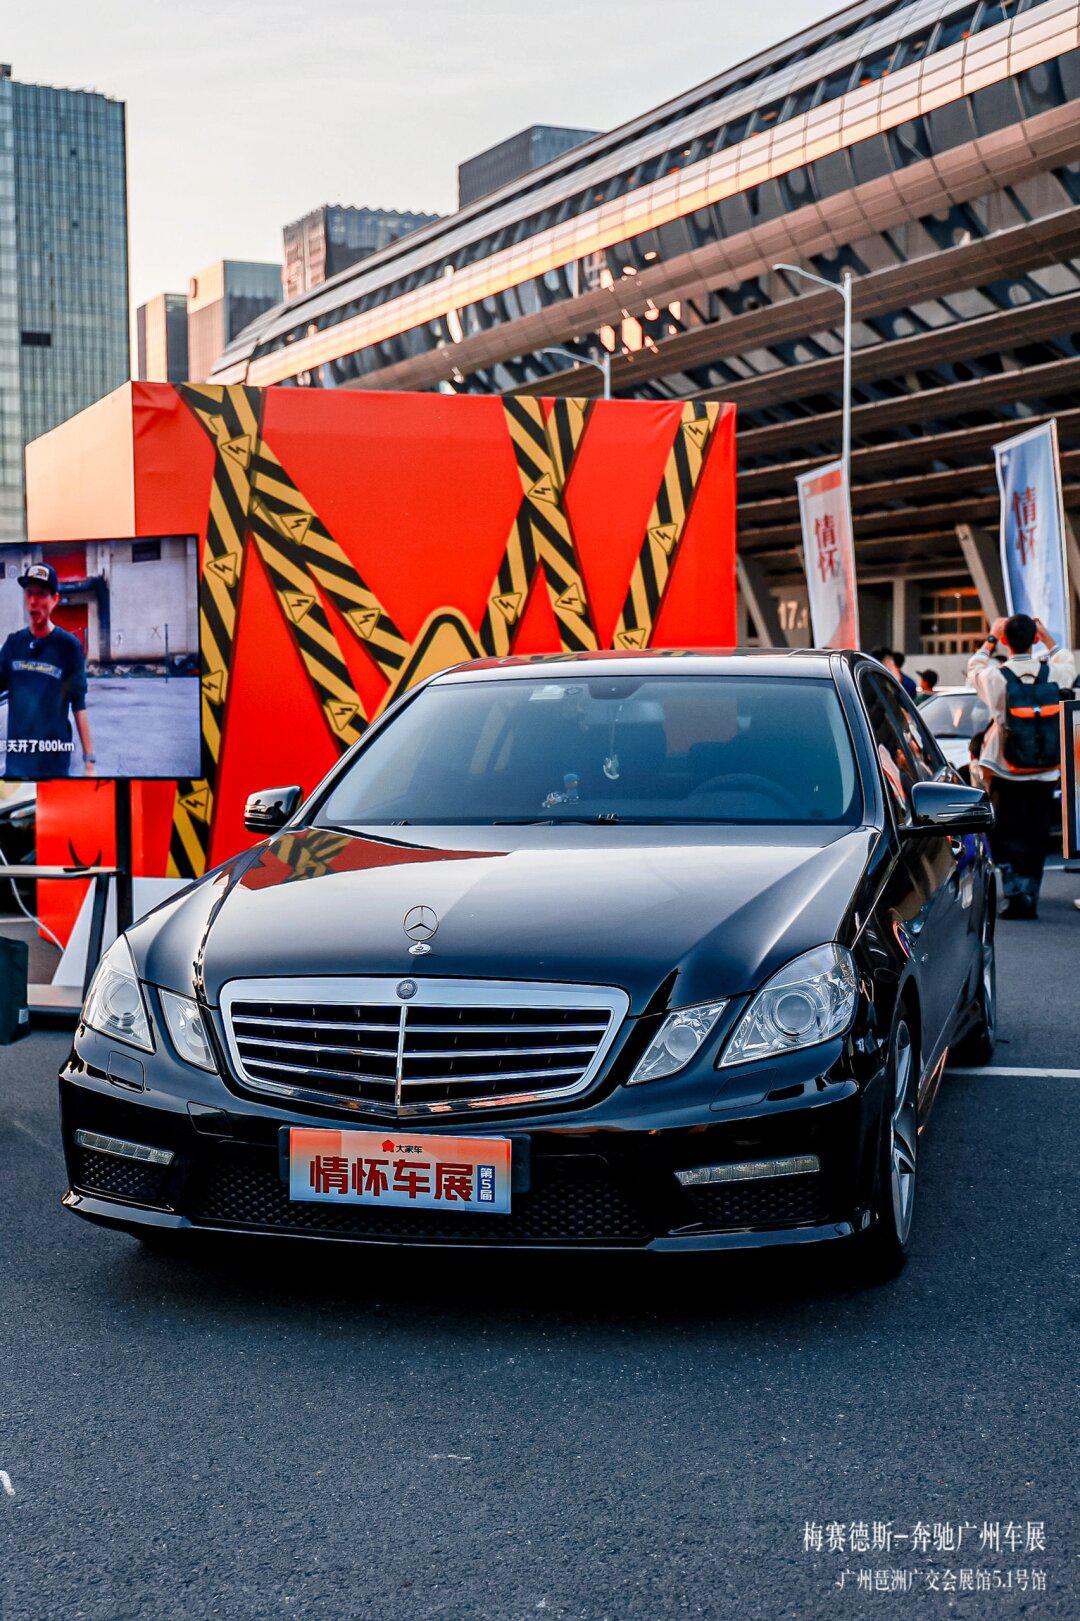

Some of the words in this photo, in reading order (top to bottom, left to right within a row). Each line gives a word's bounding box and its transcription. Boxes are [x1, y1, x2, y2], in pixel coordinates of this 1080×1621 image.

[814, 513, 838, 583] 情怀
[1012, 486, 1036, 565] 情怀
[395, 1144, 423, 1154] 大家车
[309, 1155, 473, 1202] 情怀车展
[480, 1167, 493, 1201] 第5届
